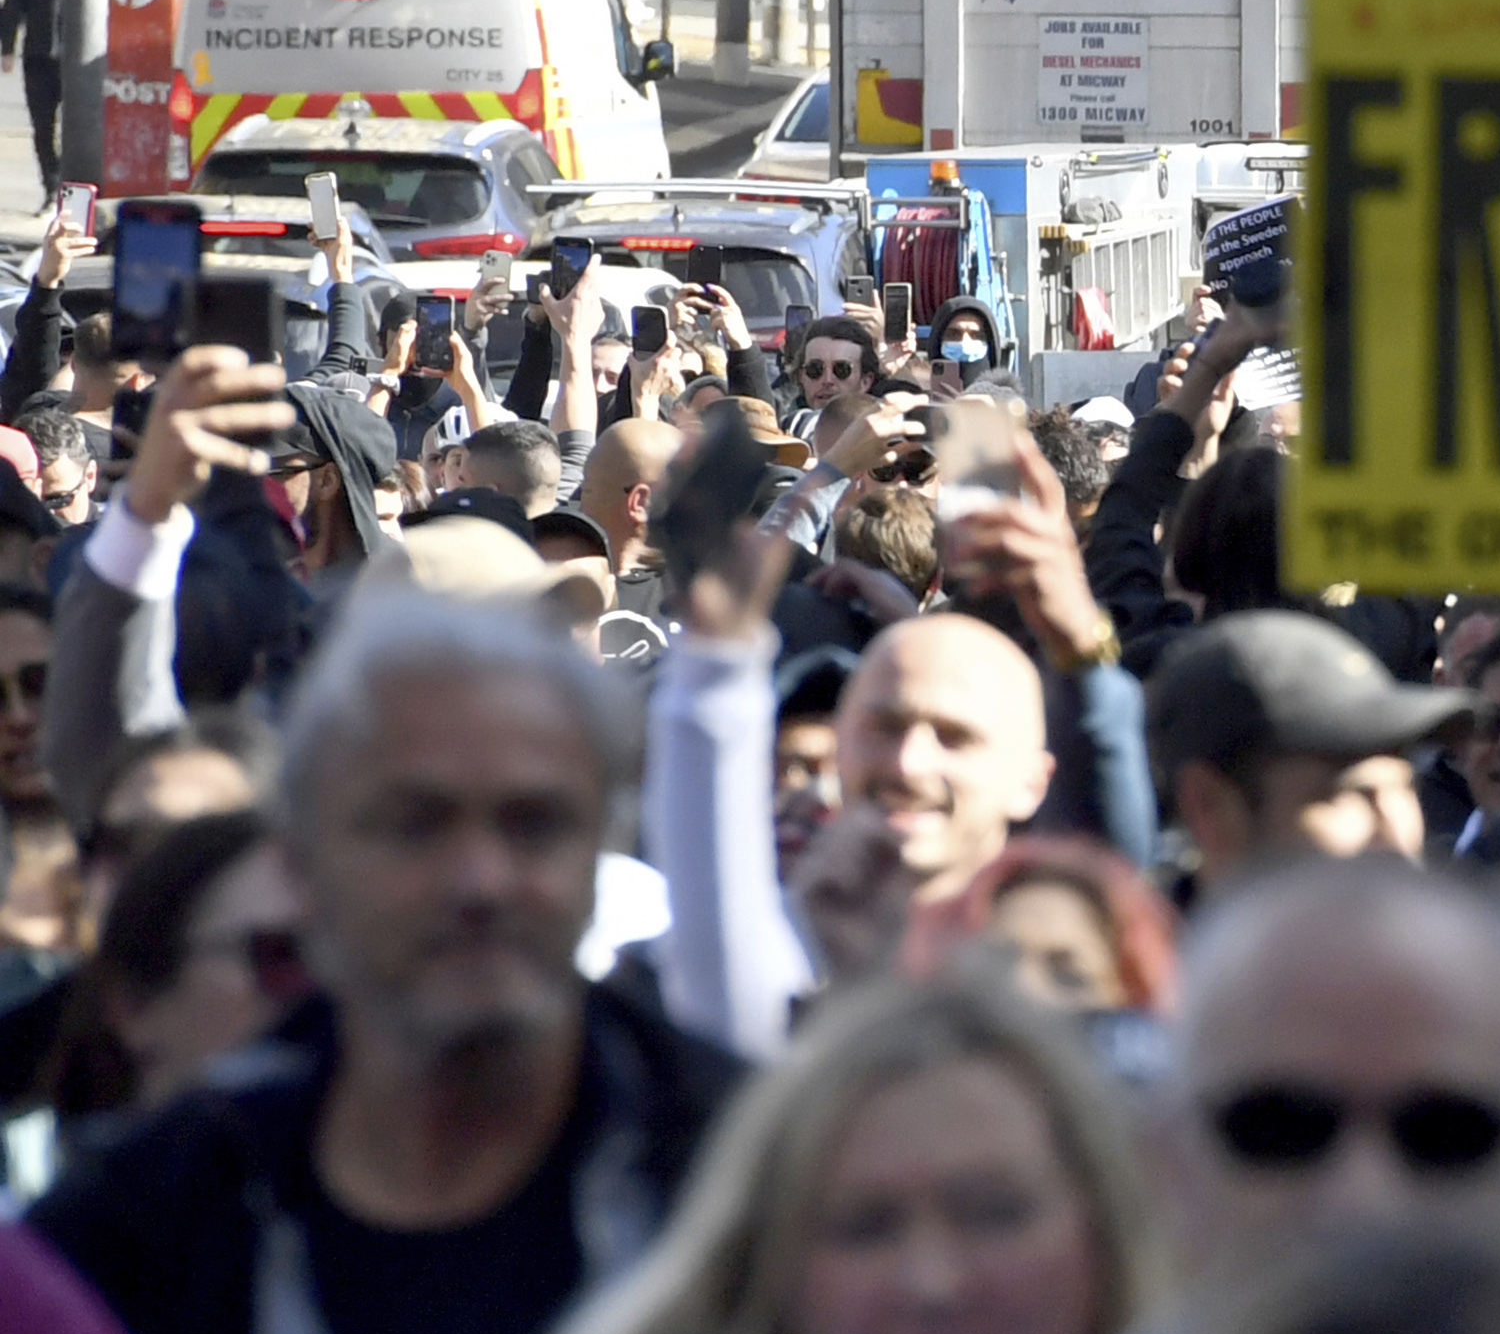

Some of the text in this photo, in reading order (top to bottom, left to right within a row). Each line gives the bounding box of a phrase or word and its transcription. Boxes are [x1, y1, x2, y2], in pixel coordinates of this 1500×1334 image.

[1044, 21, 1142, 35] JOBS AVAILABLE
[206, 27, 502, 49] INCIDENT RESPONSE
[1081, 37, 1104, 49] FOR
[1042, 56, 1141, 68] DIESEL MECHANICS
[446, 69, 481, 83] CITY
[1060, 75, 1126, 88] AT MICWAY
[103, 81, 170, 105] POST
[1041, 107, 1146, 122] 1300 MICWAY
[1190, 120, 1234, 135] 1001
[1218, 206, 1283, 236] THE PEOPLE
[1221, 224, 1287, 253] the Sweden
[1219, 246, 1273, 272] approach
[1312, 507, 1436, 563] THE
